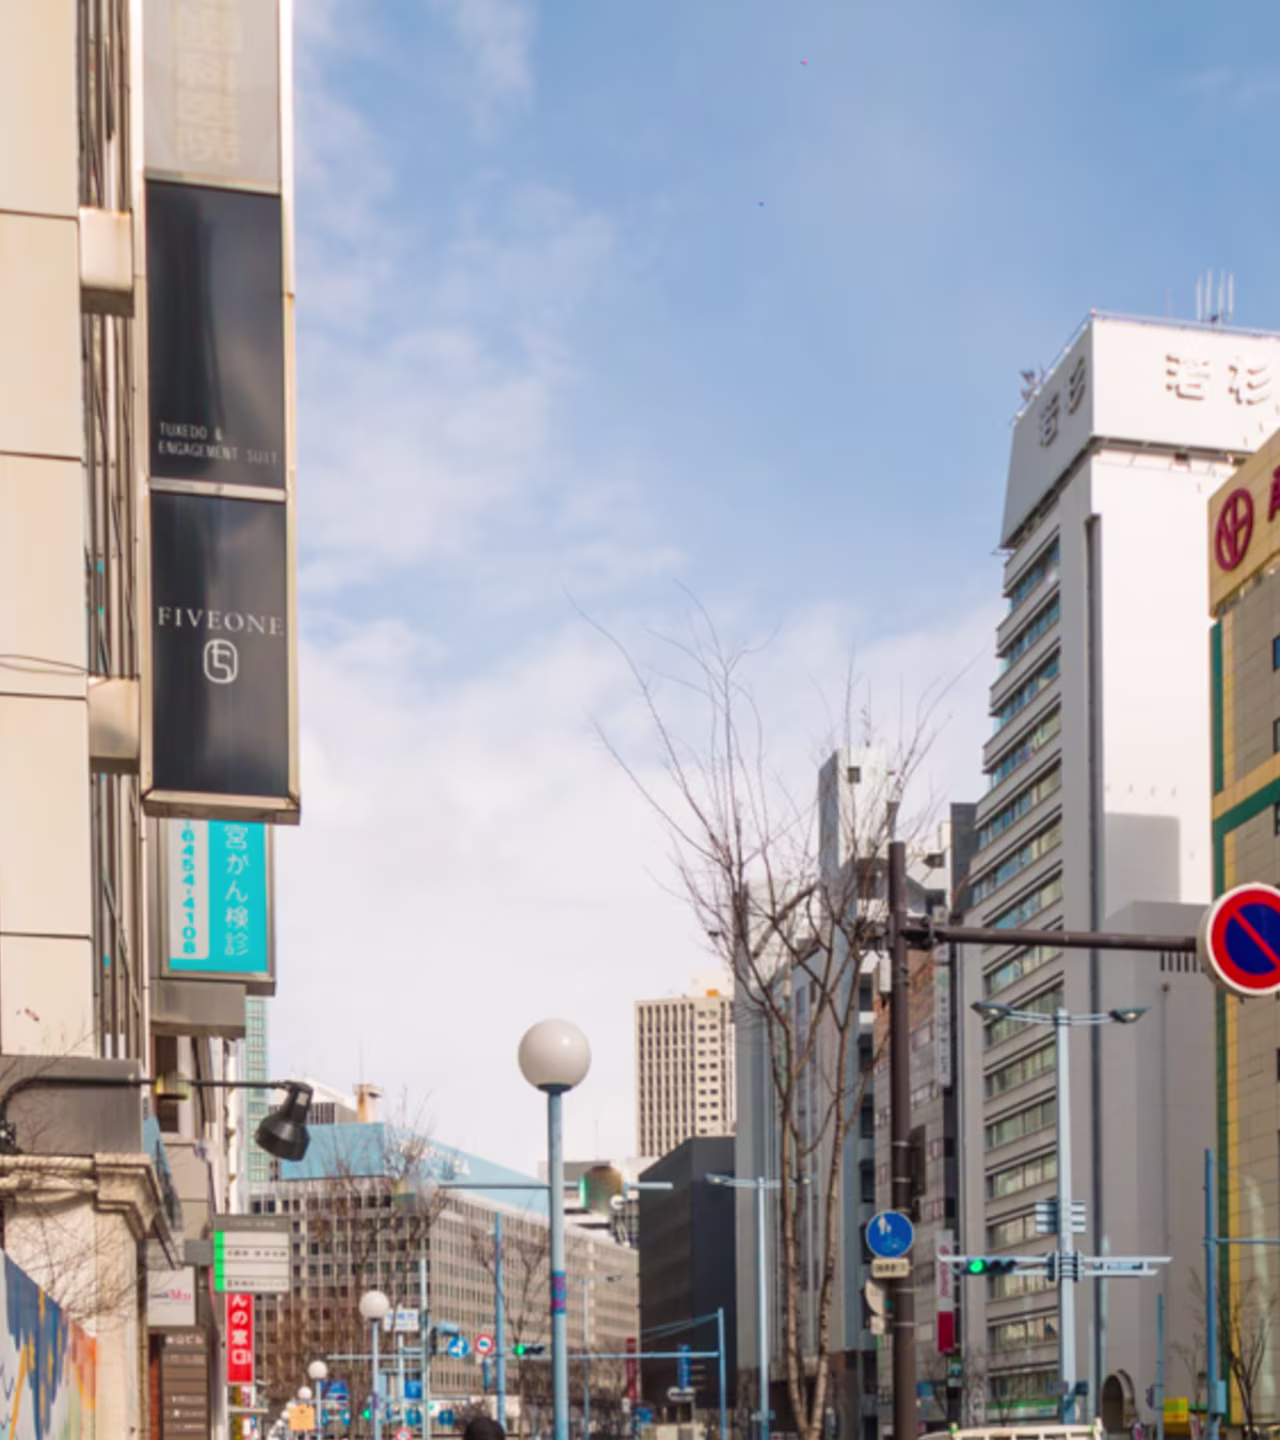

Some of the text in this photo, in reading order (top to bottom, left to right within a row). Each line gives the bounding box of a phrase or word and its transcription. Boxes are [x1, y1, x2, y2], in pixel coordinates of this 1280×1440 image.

[159, 421, 208, 440] TUXEDO
[158, 440, 278, 465] ENGAGEMENT SUIT
[158, 606, 284, 636] FIVEONE
